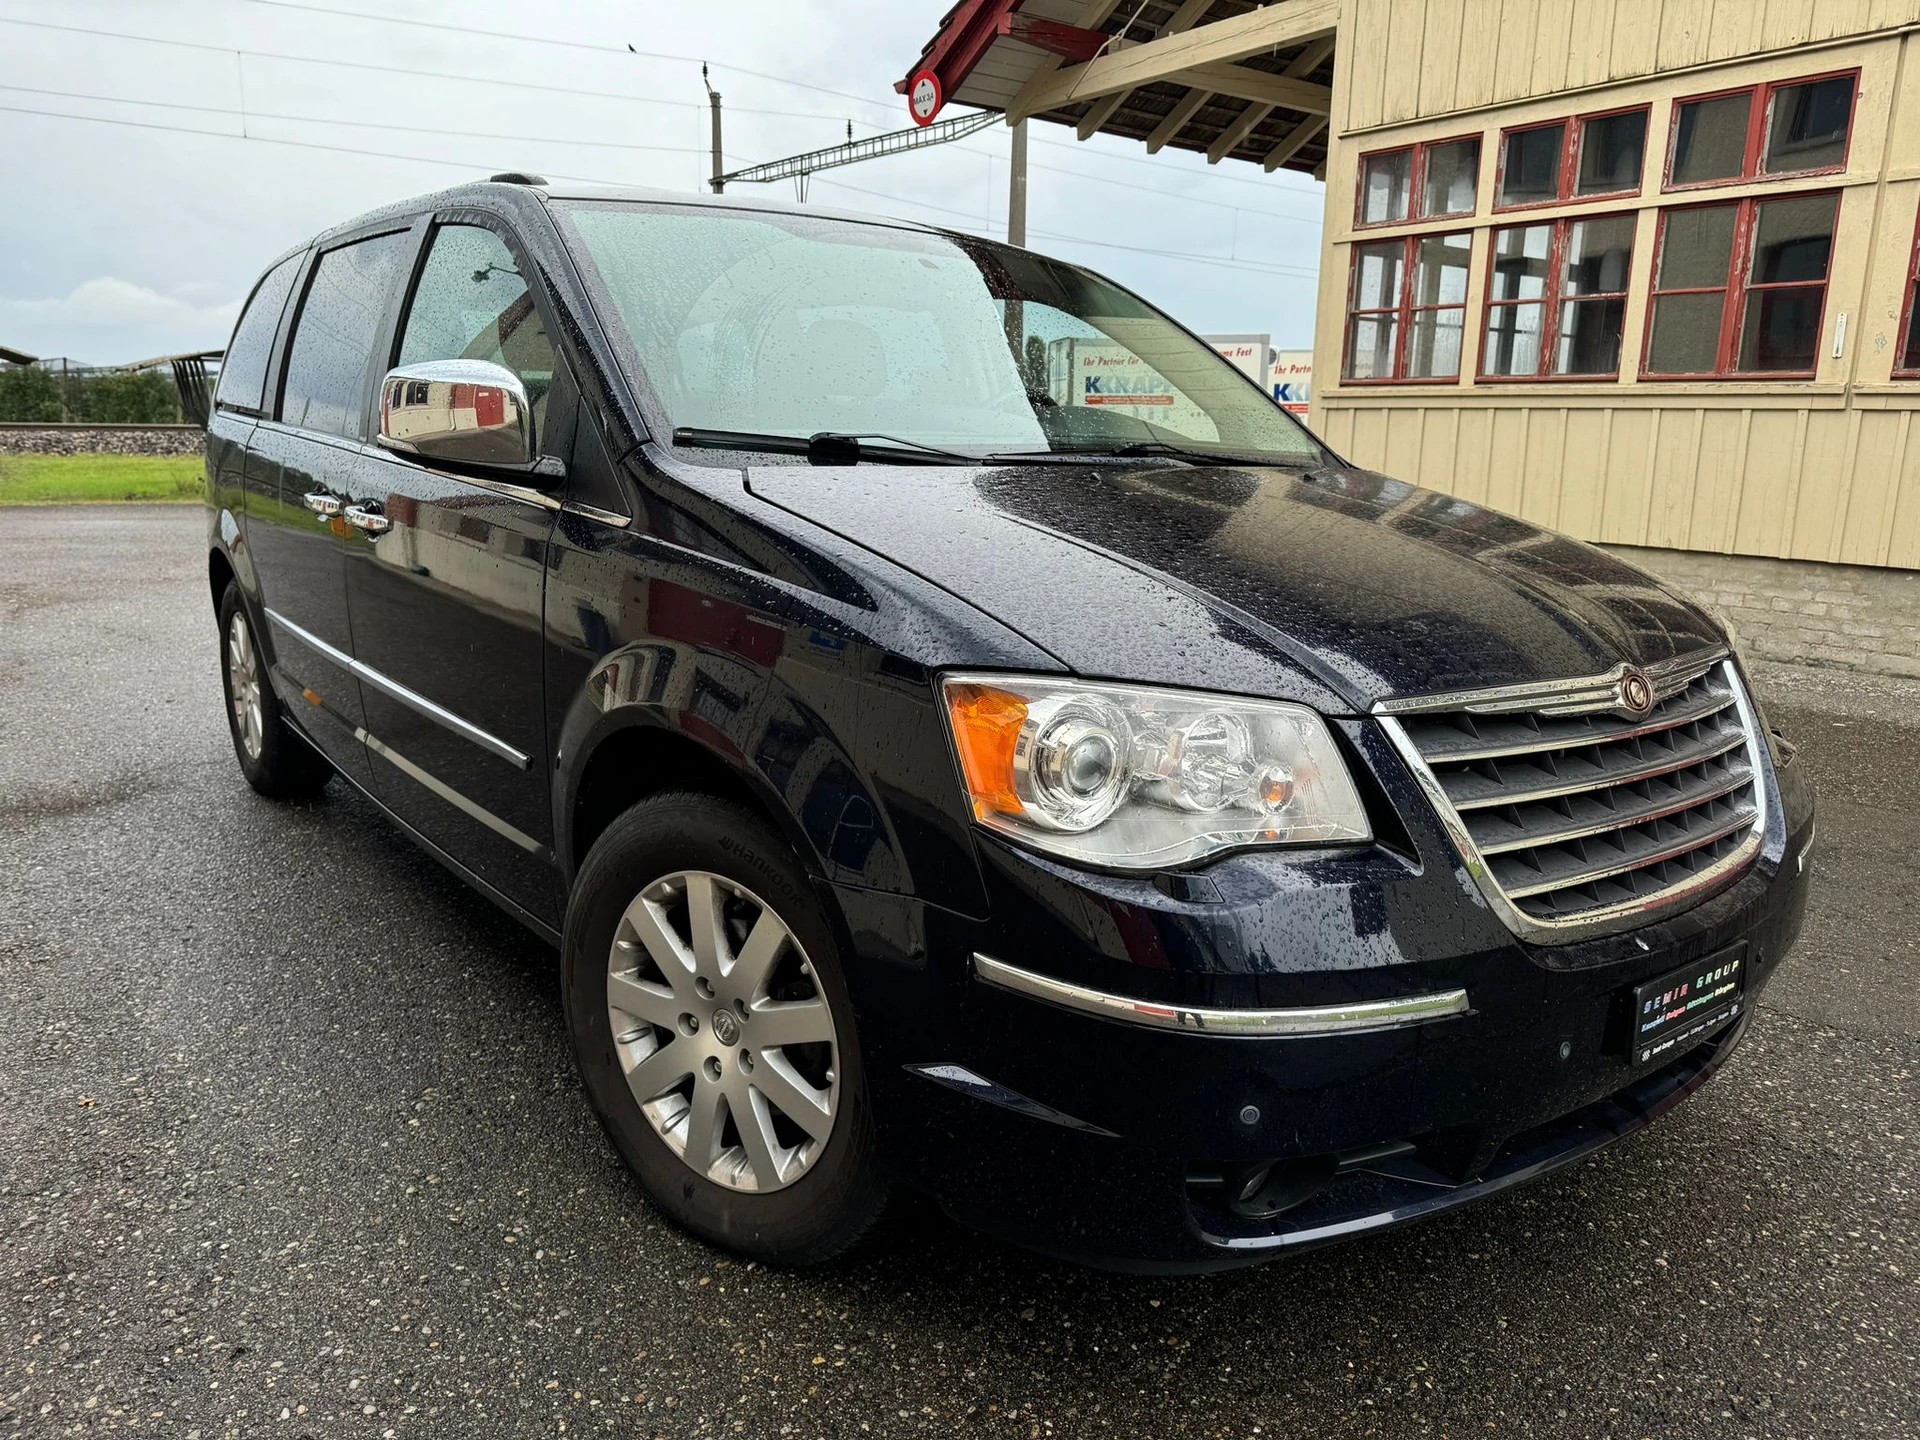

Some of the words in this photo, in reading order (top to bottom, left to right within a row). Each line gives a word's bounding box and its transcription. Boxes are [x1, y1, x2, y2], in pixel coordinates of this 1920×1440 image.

[1084, 357, 1094, 366] Ihr
[1098, 356, 1125, 366] Partner
[1275, 364, 1286, 374] Ihr
[1696, 960, 1739, 989] GROUP
